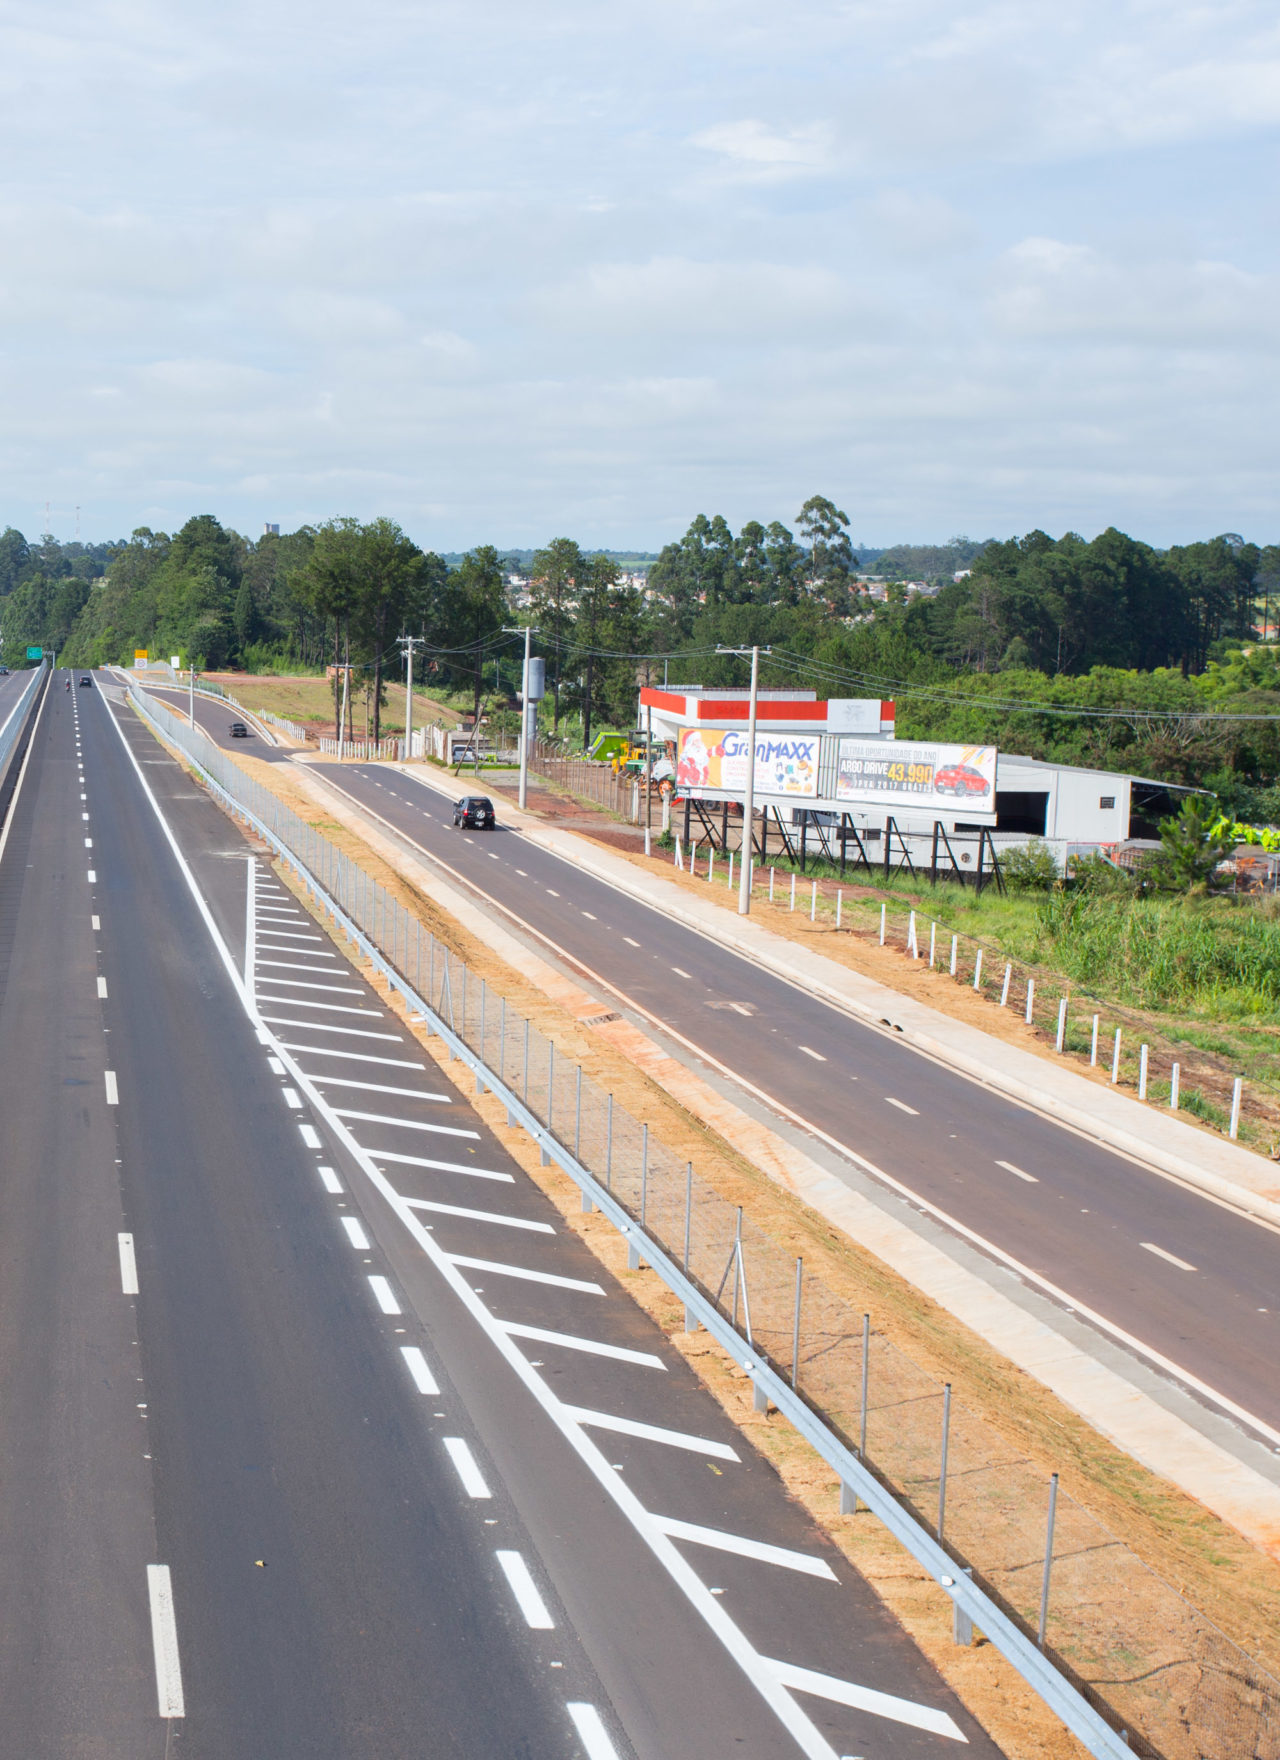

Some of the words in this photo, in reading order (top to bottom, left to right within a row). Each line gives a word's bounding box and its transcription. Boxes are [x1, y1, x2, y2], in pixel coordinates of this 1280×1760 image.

[913, 750, 923, 760] DO
[923, 751, 937, 761] ANO
[840, 759, 862, 773] ARGO
[863, 761, 889, 775] DRIVE
[888, 763, 933, 783] 43.990
[877, 780, 898, 790] 2017
